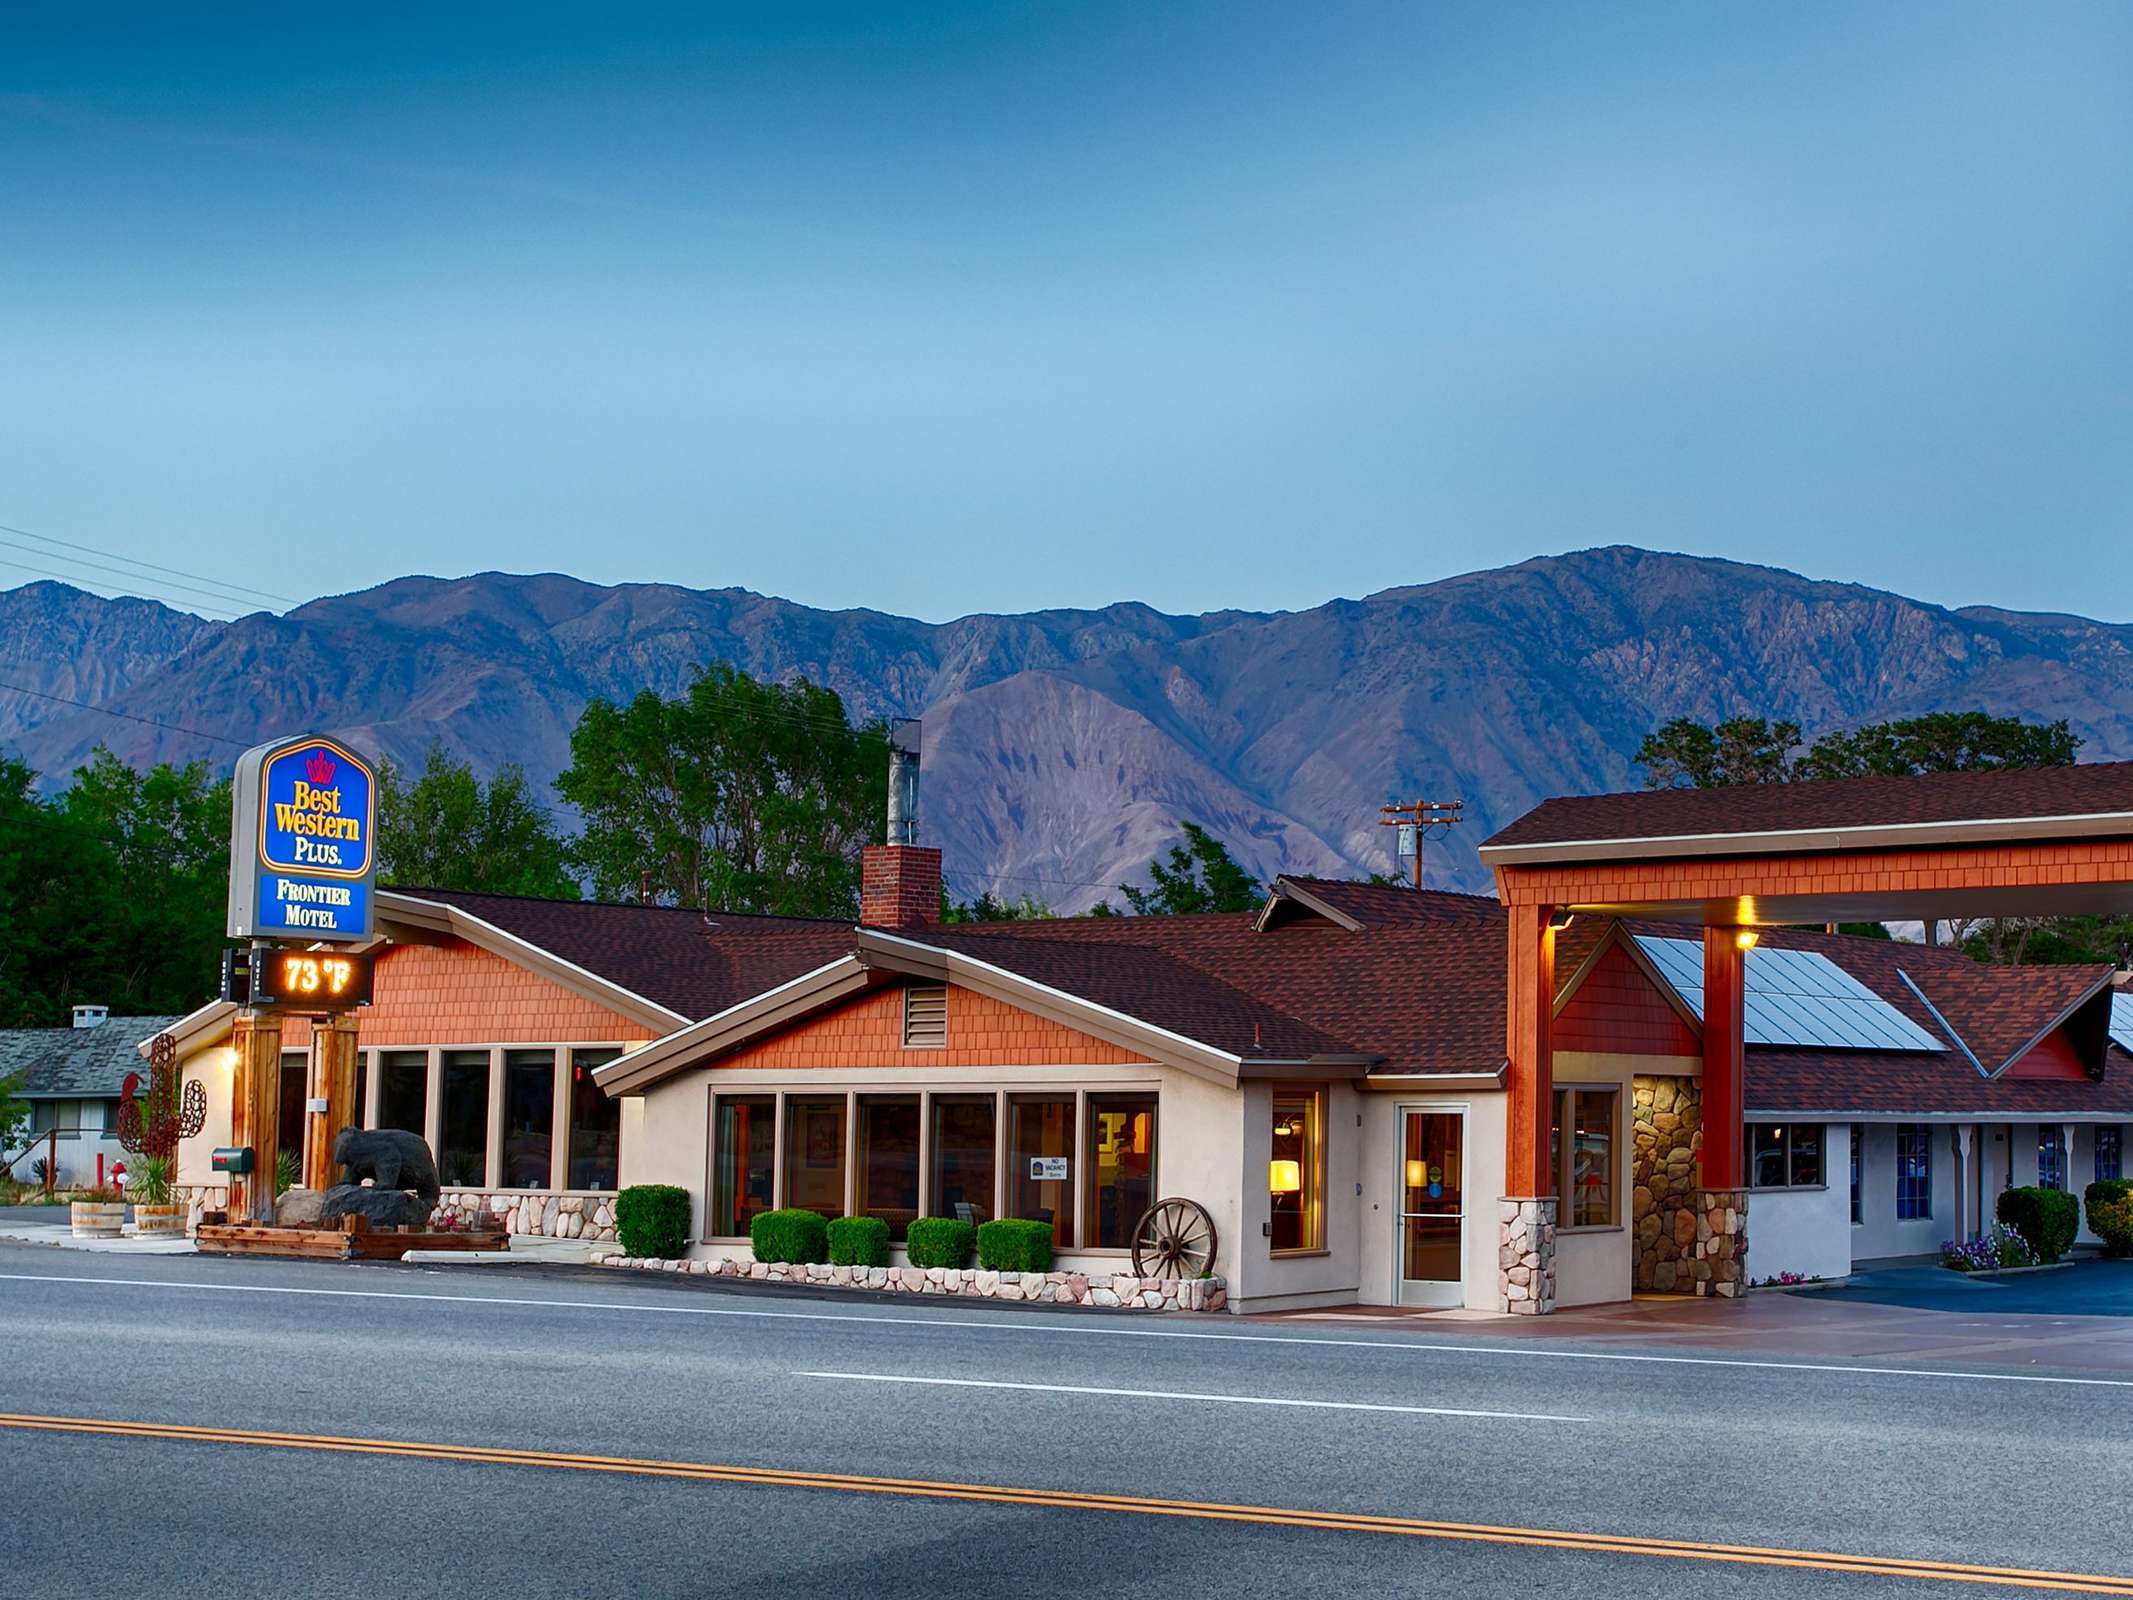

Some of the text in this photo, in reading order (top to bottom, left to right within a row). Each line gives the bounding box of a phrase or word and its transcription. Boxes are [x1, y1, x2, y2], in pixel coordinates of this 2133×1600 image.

[294, 781, 342, 814] Best
[274, 803, 360, 841] Western
[277, 878, 351, 906] FRONTIER
[285, 904, 337, 929] MOTEL
[286, 959, 319, 991] 73
